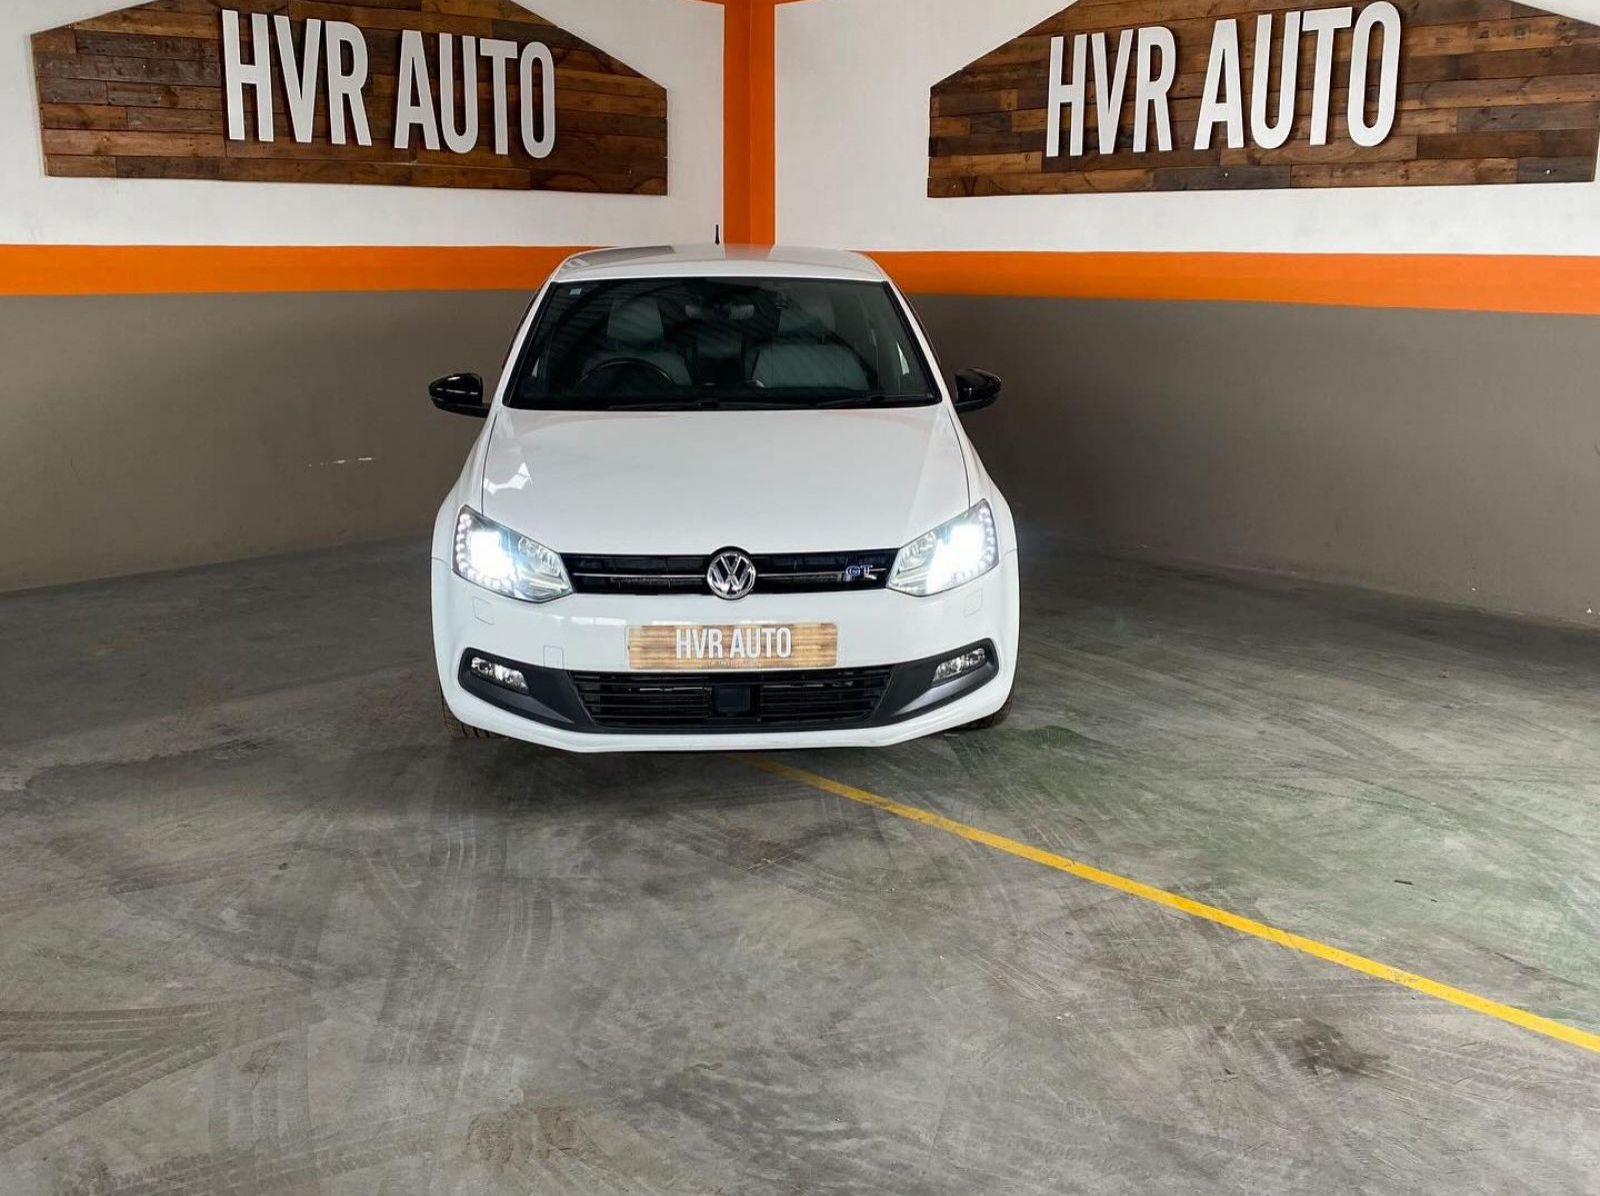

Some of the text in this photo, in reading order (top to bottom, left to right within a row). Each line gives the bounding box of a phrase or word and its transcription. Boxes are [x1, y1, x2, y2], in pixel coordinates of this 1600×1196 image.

[222, 10, 556, 158] HVR AUTO
[1046, 1, 1401, 157] HVR AUTO
[708, 552, 755, 598] VW
[676, 626, 791, 659] HVR AUTO
